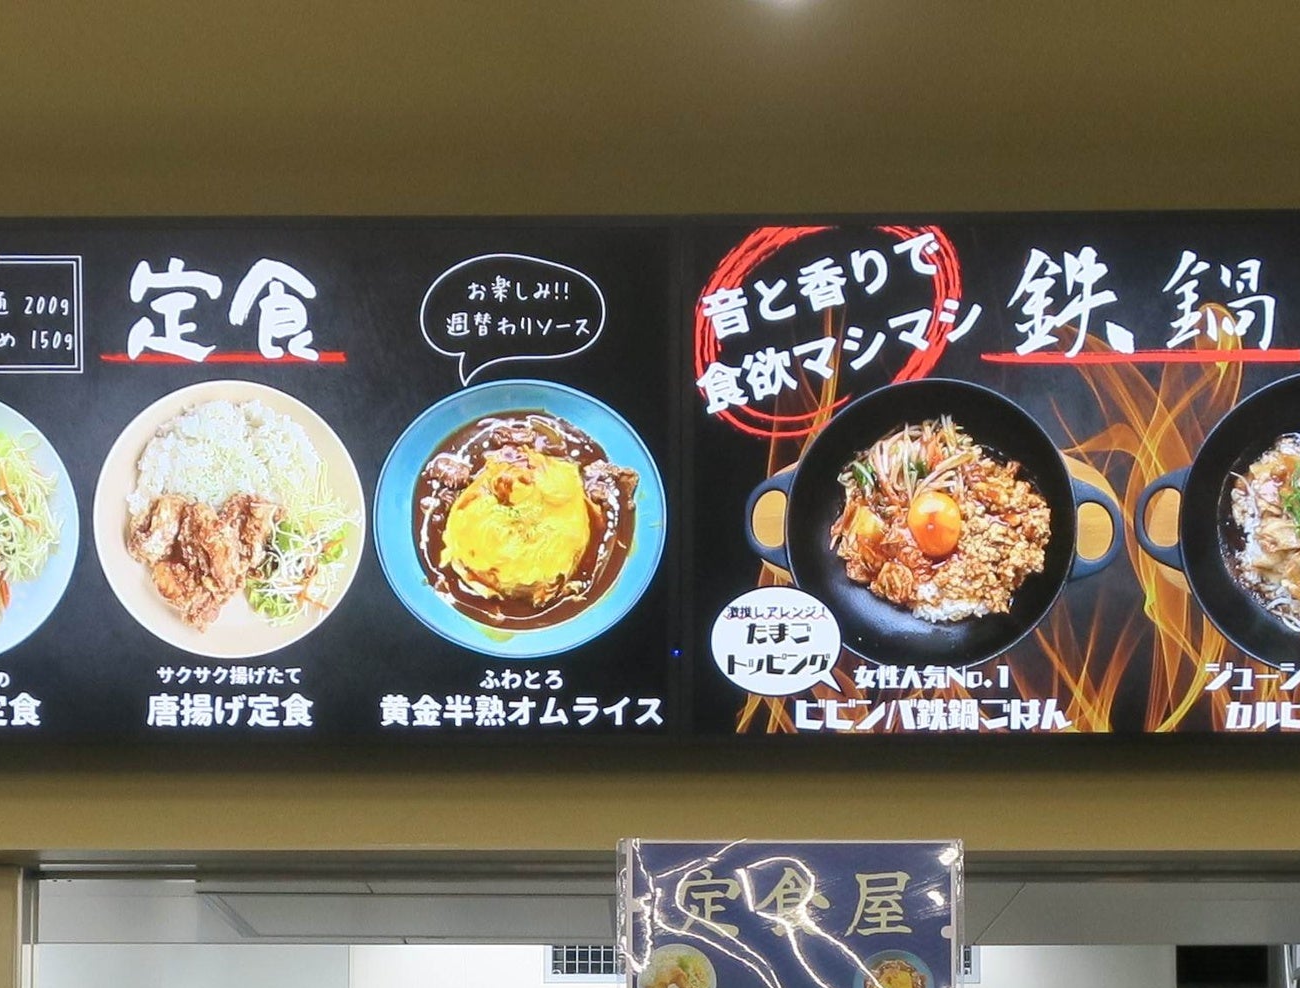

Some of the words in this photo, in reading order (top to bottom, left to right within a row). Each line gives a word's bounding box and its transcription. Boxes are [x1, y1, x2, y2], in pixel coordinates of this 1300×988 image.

[701, 232, 940, 339] 音と香りで
[24, 296, 69, 315] 200g
[127, 257, 319, 362] 定食
[1006, 245, 1277, 357] 鉄鍋
[445, 312, 592, 337] 週替わりソース
[31, 329, 74, 351] 150g
[696, 297, 983, 414] 食欲マシマシ
[746, 623, 812, 644] たまご
[156, 665, 302, 686] サクサク揚げたて
[727, 653, 831, 675] トッピング
[853, 664, 1009, 690] 女性人気No.1
[479, 669, 564, 690] ふわとろ
[147, 692, 314, 727] 唐揚げ定食
[380, 694, 664, 727] 黄金半熟オムライス
[795, 698, 1073, 731] ビビンバ鉄鍋ごはん
[677, 869, 913, 938] 定食屋
